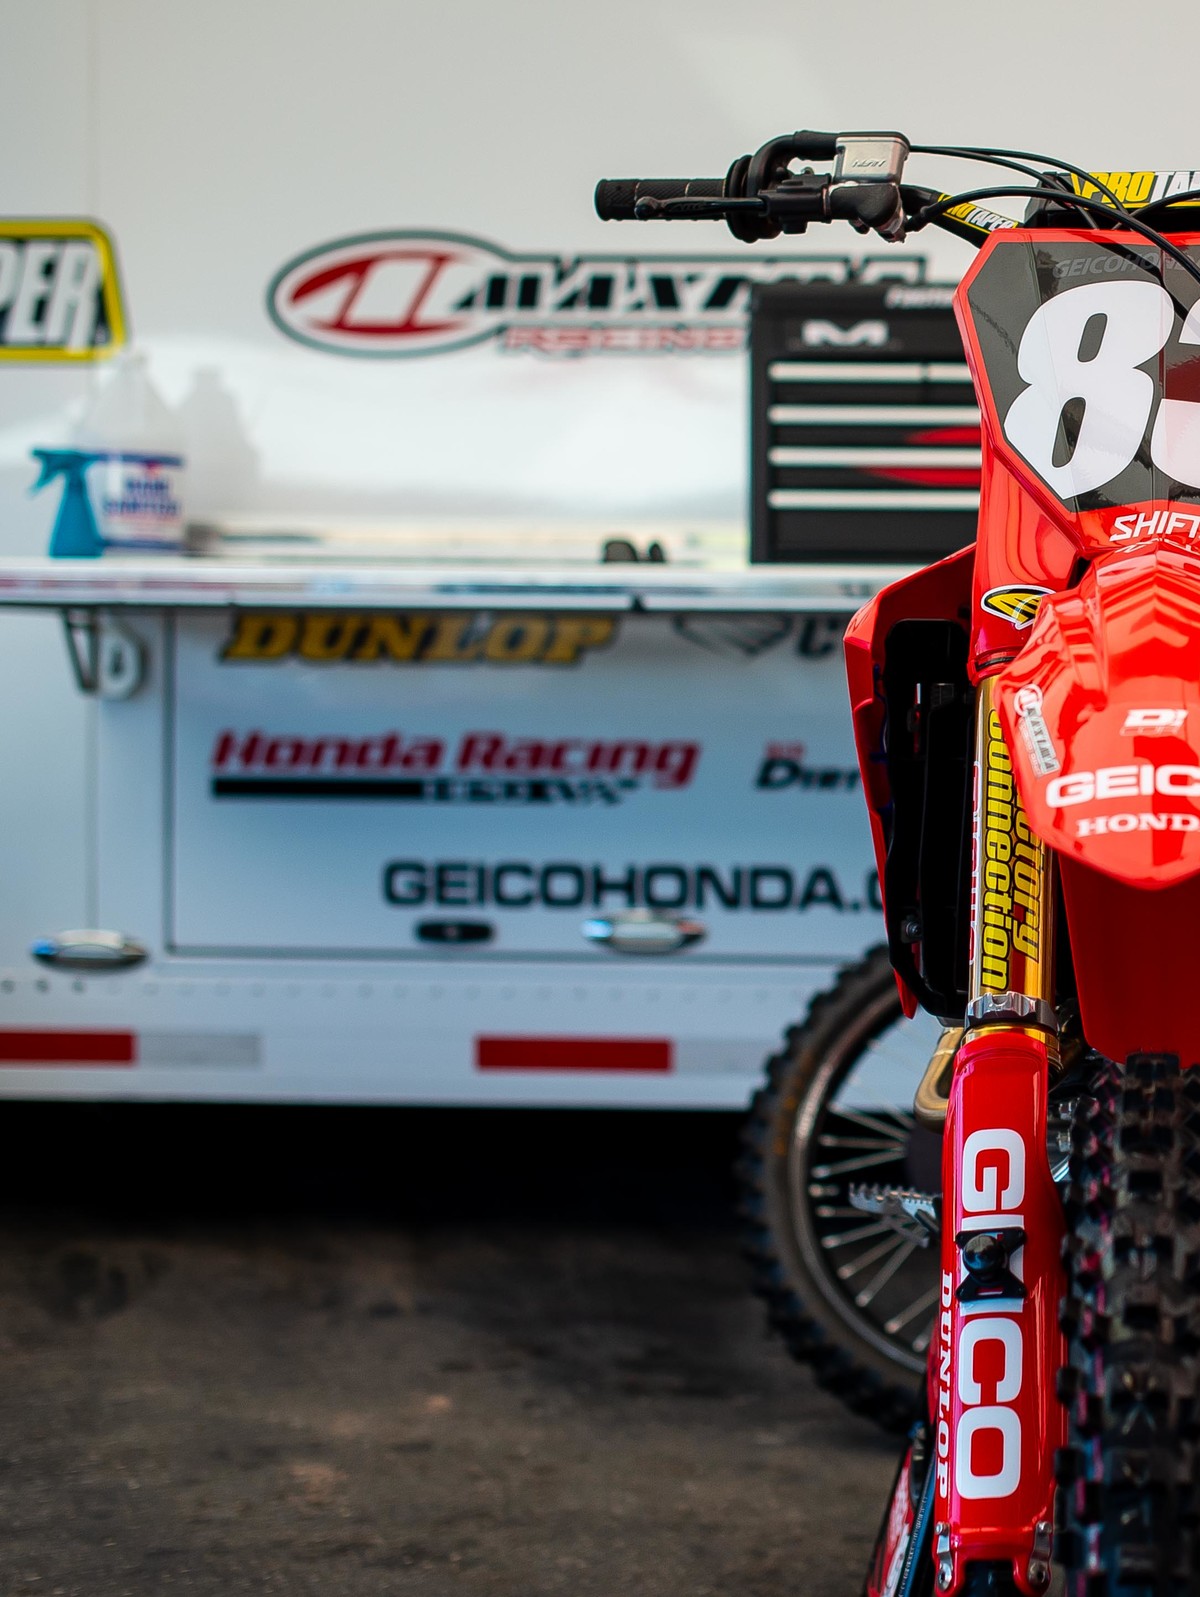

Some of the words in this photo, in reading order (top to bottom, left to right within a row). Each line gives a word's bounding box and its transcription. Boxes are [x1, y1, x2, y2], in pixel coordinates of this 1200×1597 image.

[226, 613, 613, 664] DUNLOP
[212, 730, 449, 772] Honda
[456, 731, 702, 790] Racing
[937, 1270, 953, 1499] DUNLOP
